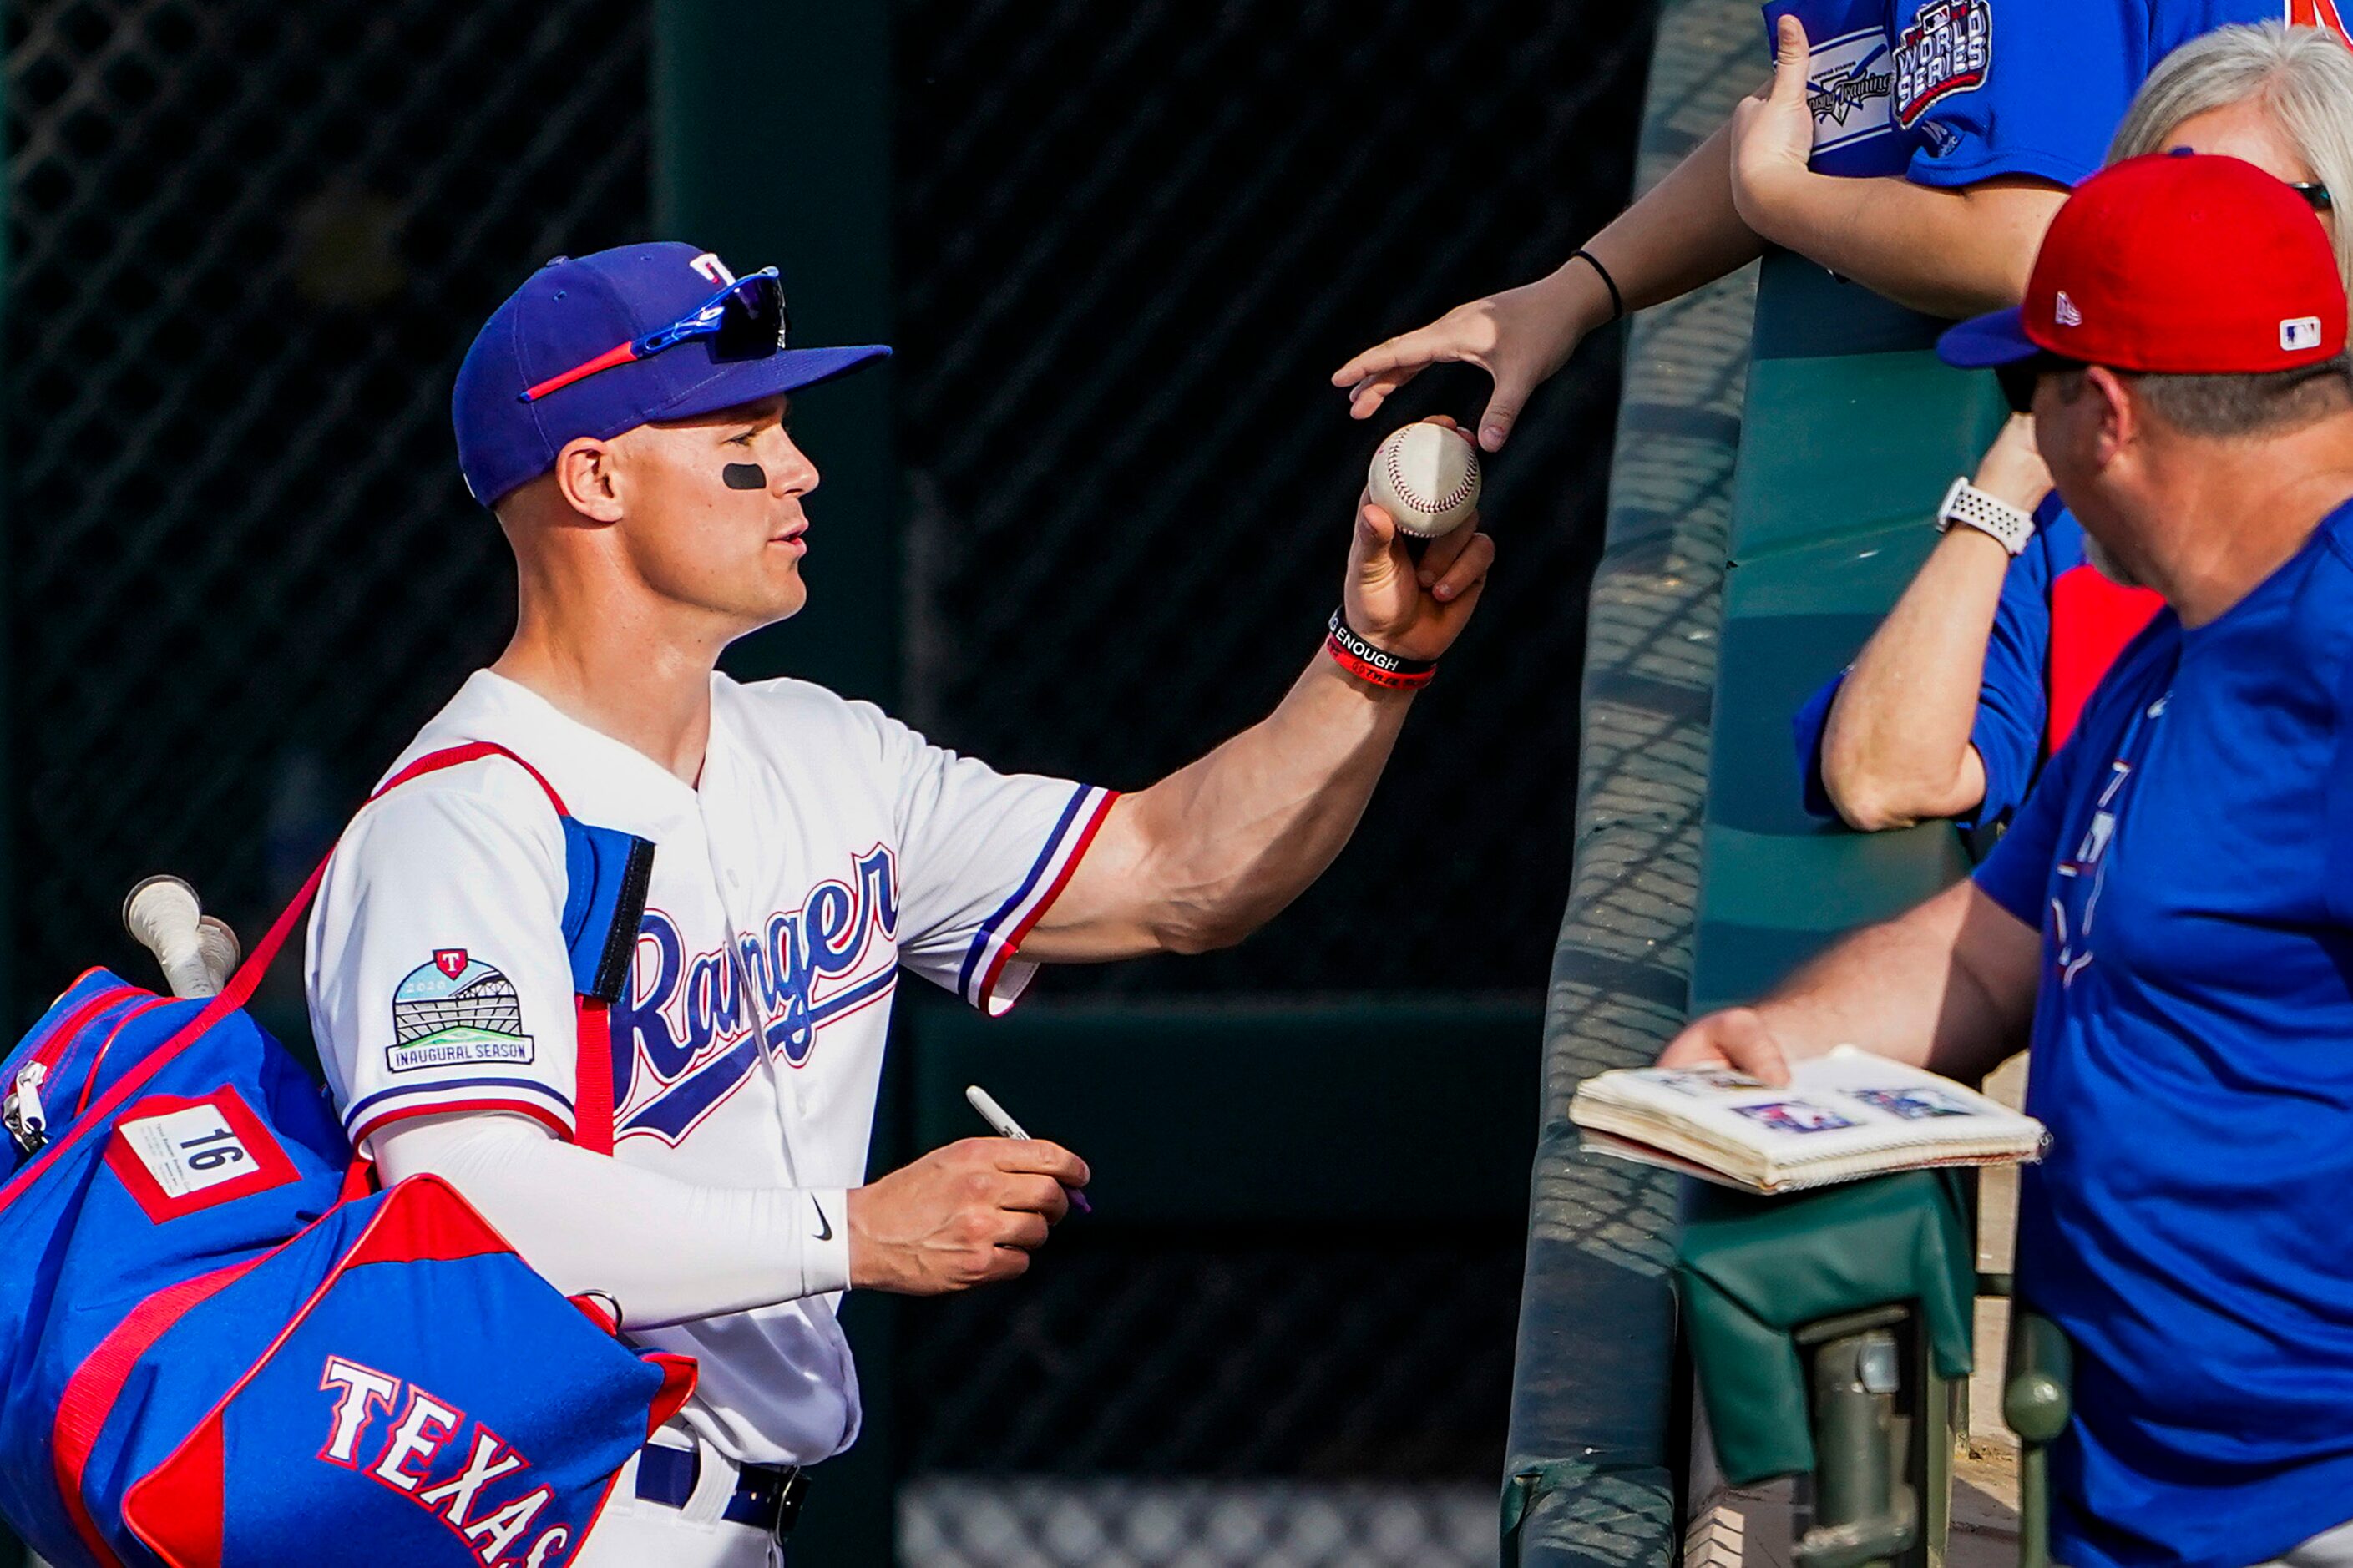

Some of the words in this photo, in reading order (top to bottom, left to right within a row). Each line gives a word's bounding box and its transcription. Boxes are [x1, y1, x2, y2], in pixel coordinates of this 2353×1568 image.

[1899, 8, 1986, 73] WORLD
[1834, 67, 1893, 106] Training
[1898, 36, 1986, 112] SERIES
[1336, 627, 1399, 671] ENOUGH
[442, 953, 459, 972] T
[406, 979, 447, 994] 2020
[396, 1045, 473, 1067] INAUGURAL
[476, 1044, 526, 1059] SEASON
[180, 1128, 244, 1171] 16
